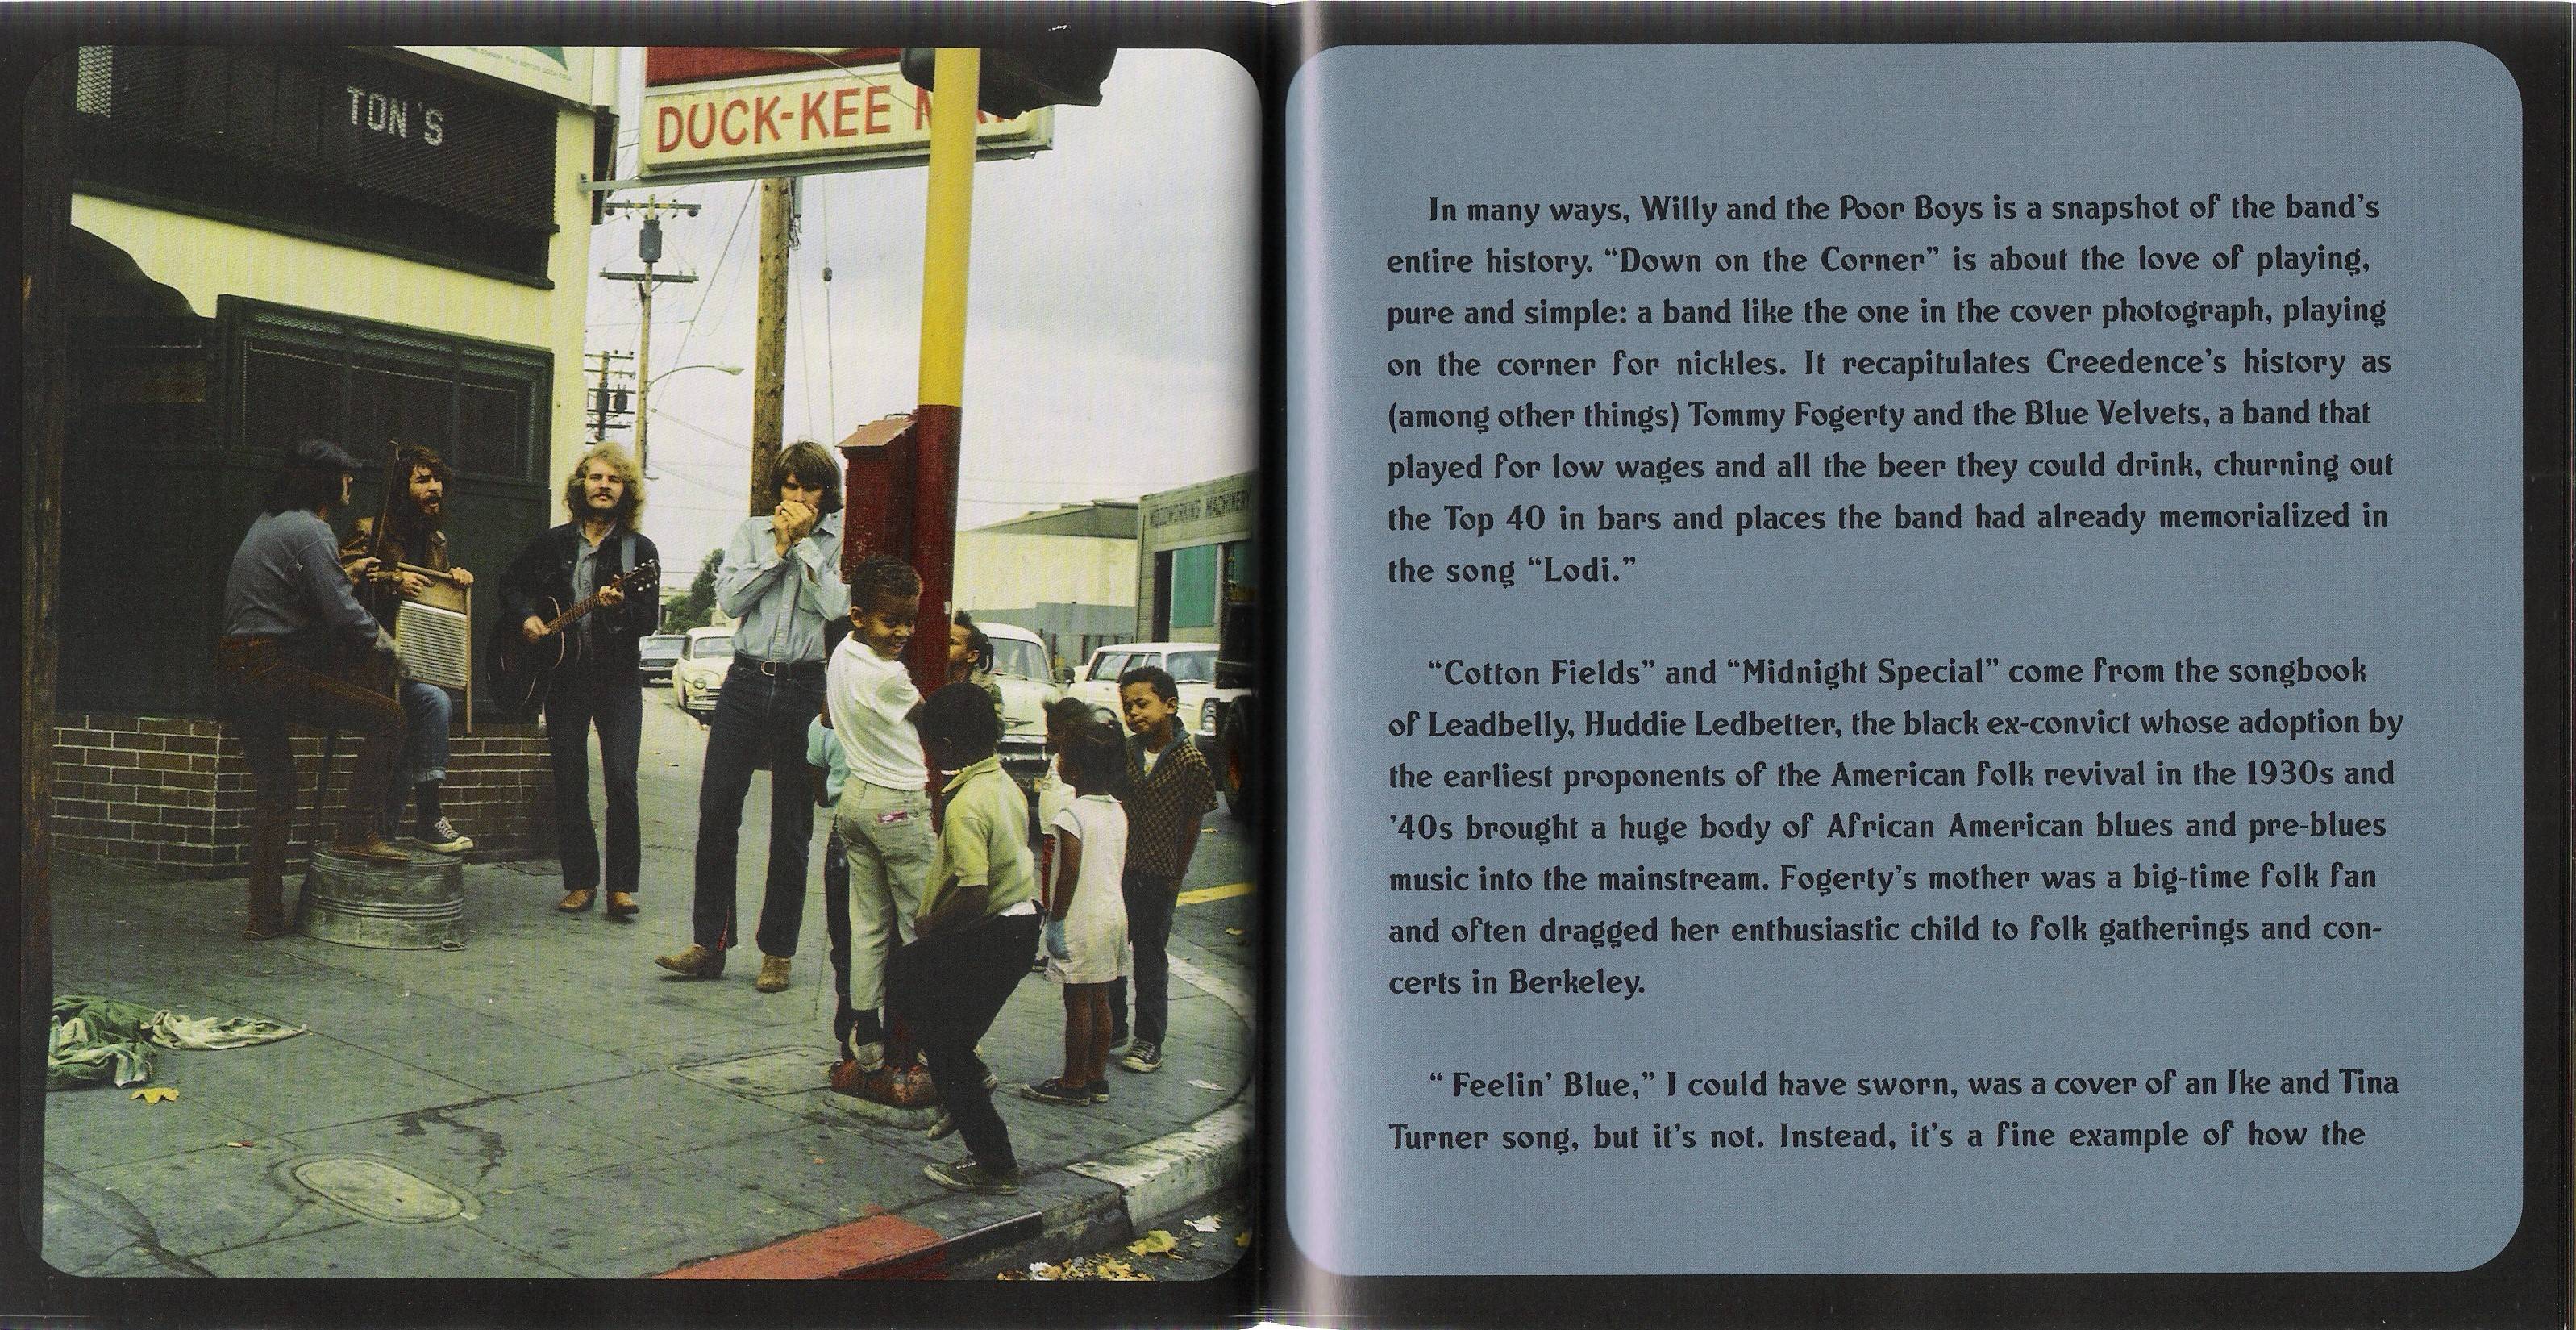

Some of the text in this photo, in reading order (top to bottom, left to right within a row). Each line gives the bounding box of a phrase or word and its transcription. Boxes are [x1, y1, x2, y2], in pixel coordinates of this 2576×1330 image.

[657, 85, 891, 153] DUCK-KEE
[1429, 192, 2380, 229] In many ways, Willy and the Poor Boys is a snapshot of the band’s
[1386, 244, 2370, 280] entire history. “Down on the Corner” is about the love of playing,
[1387, 347, 2392, 381] on the corner for nickles. It recapitulates Creedence’s history as
[1388, 398, 2371, 435] (among other things) Tommy Fogerty and the Blue Velvets, a band that
[1388, 501, 2388, 538] the Top 40 in bars and places the band had already memorialized in
[1388, 556, 1636, 590] the song “Lodi.”
[1428, 656, 2367, 691] “Cotton Fields” and “Midnight Special” come from the songbook
[1388, 707, 2403, 744] of Leadbelly, Huddie Ledbetter, the black ex-convict whose adoption by
[1389, 759, 2395, 794] the earliest proponents of the American folk revival in the 1930s and
[1389, 810, 2387, 847] ’40s brought a huge body of African American blues and pre-blues
[1389, 861, 2377, 898] music into the mainstream. Fogerty’s mother was a big-time folk fan
[1563, 1070, 1655, 1100] Blue,”
[1667, 1071, 1676, 1097] I
[1688, 1069, 1767, 1097] could
[1778, 1069, 1847, 1097] have
[1857, 1078, 1958, 1099] sworn,
[1967, 1077, 2023, 1096] was
[2030, 1077, 2046, 1095] a
[2054, 1076, 2137, 1095] cover
[2145, 1068, 2177, 1095] of
[2185, 1076, 2217, 1095] an
[2228, 1068, 2271, 1095] Ike
[2279, 1068, 2330, 1094] and
[2338, 1068, 2399, 1094] Tina
[1388, 1119, 2366, 1156] Turner song, but it’s not. Instead, it’s a fine example of how the
